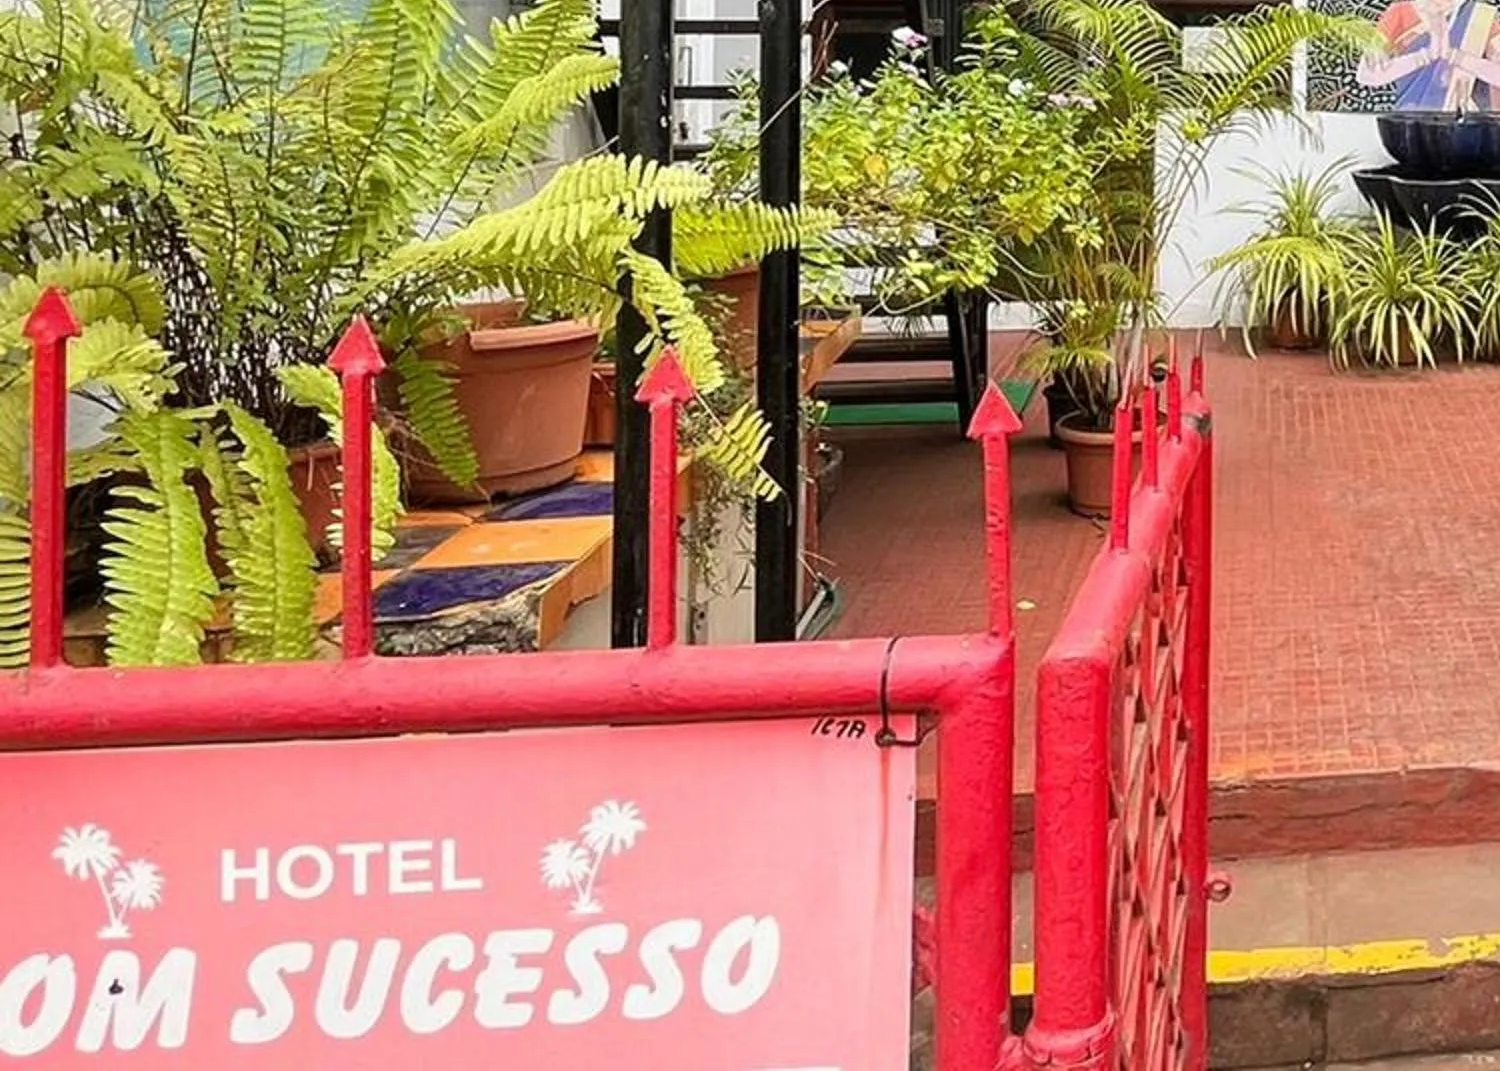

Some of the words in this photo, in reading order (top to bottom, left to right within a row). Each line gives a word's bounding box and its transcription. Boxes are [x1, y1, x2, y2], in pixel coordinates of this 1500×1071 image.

[221, 838, 483, 902] HOTEL
[0, 947, 197, 1056] OM
[230, 914, 781, 1044] SUCESSO
